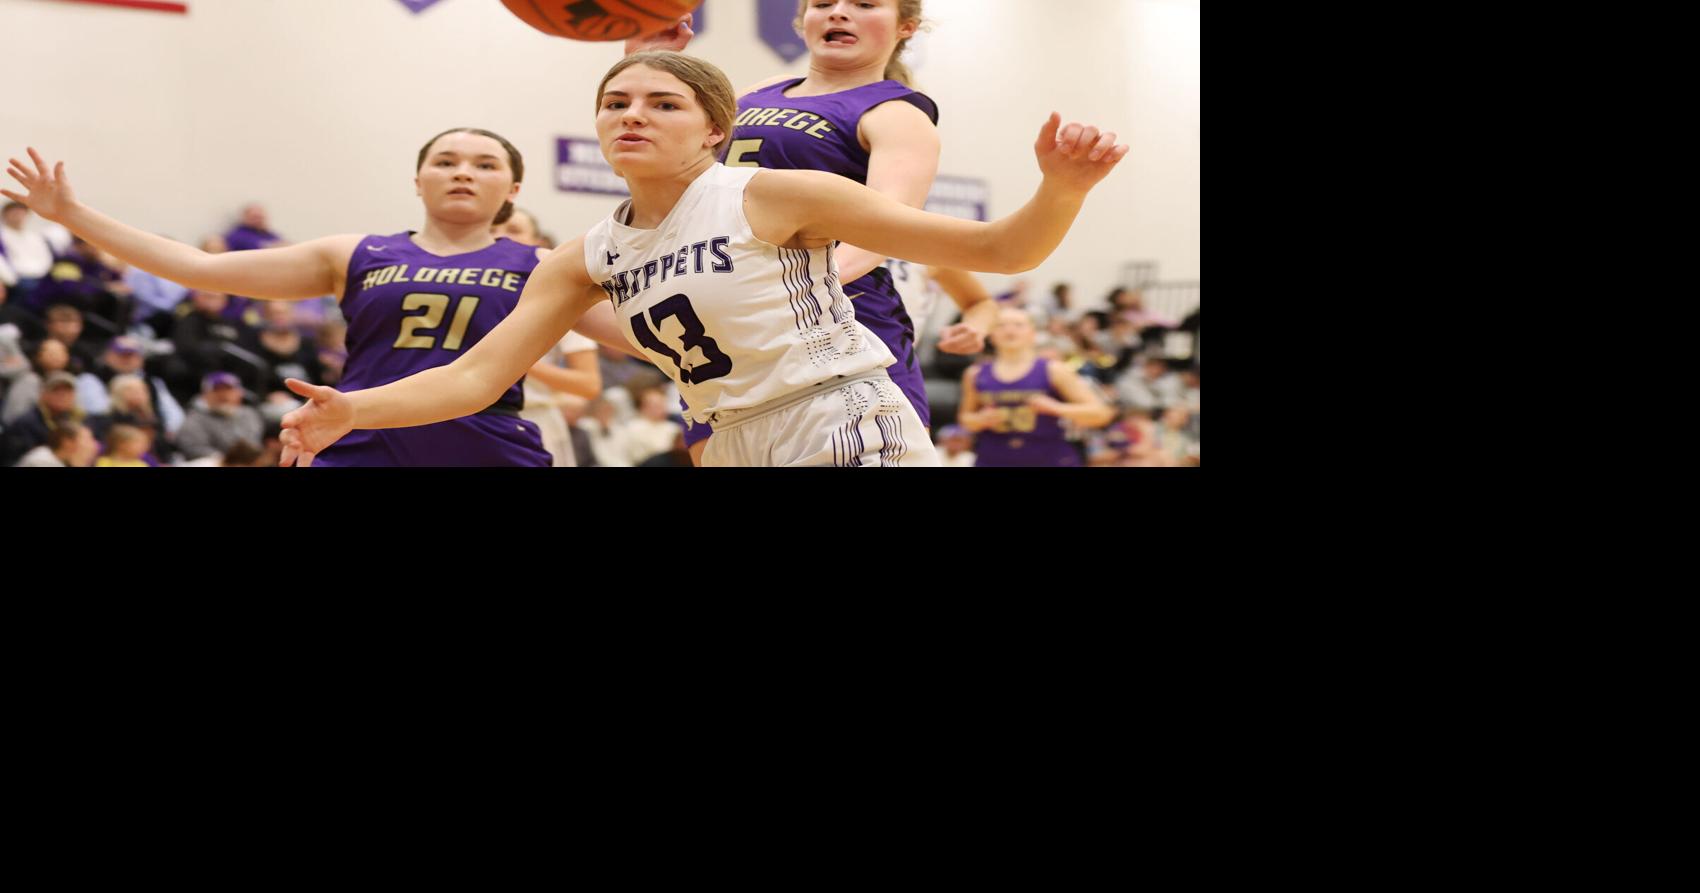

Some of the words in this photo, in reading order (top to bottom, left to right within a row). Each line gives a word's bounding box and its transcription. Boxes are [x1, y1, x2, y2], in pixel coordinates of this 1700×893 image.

[735, 107, 837, 139] DREGE
[363, 264, 522, 292] HOLDREGE
[393, 293, 480, 350] 21
[630, 293, 733, 385] 13
